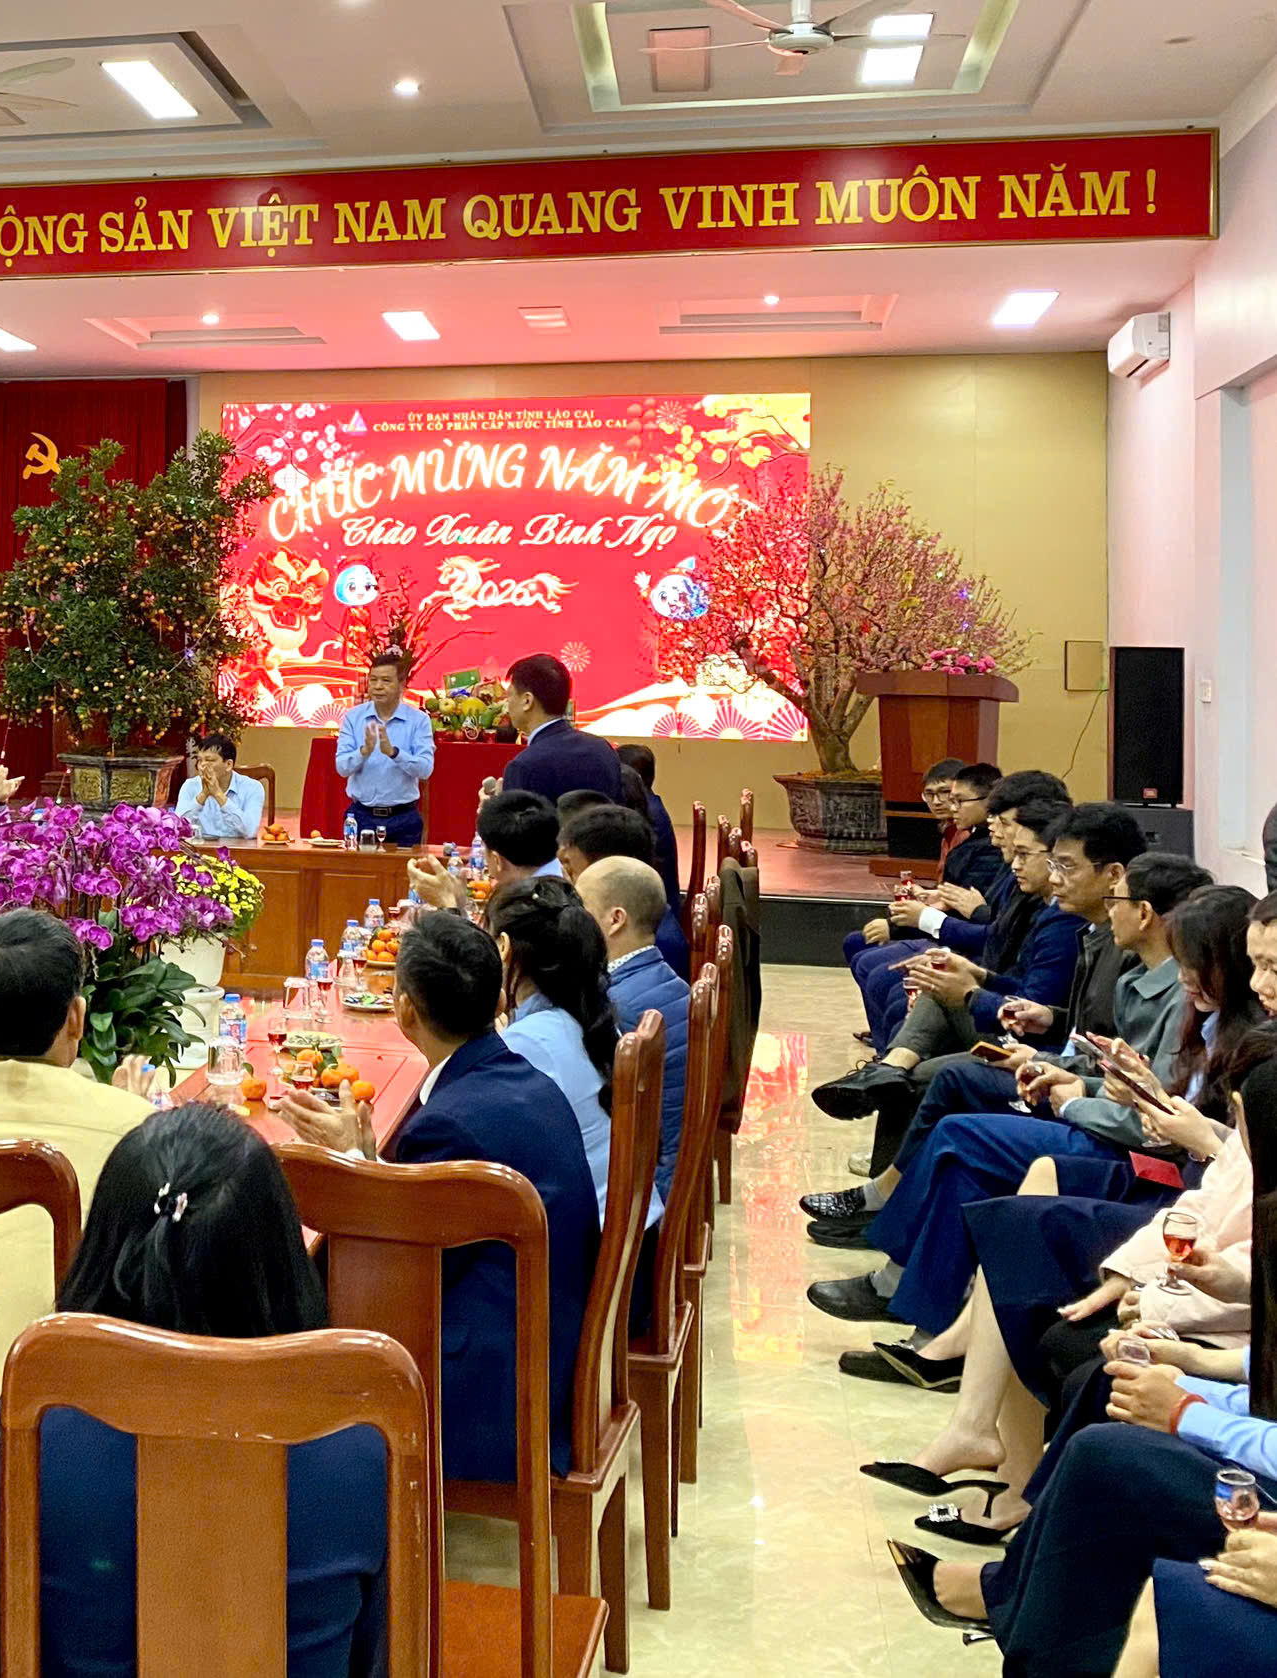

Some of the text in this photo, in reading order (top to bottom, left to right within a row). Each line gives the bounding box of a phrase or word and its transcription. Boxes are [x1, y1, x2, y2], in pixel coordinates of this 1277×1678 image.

[99, 196, 192, 253] SẢN
[207, 193, 320, 257] VIỆT
[333, 198, 446, 244] NAM
[462, 188, 642, 241] QUANG
[659, 182, 800, 230] VINH
[815, 164, 981, 225] MUÔN
[998, 162, 1131, 219] NĂM
[373, 421, 405, 432] CÔNG
[409, 423, 423, 431] TY
[606, 418, 628, 428] CAI
[390, 438, 527, 500] MỪNG
[535, 443, 647, 505] NĂM
[341, 512, 677, 557] Chào Xuân Bính Ngọ
